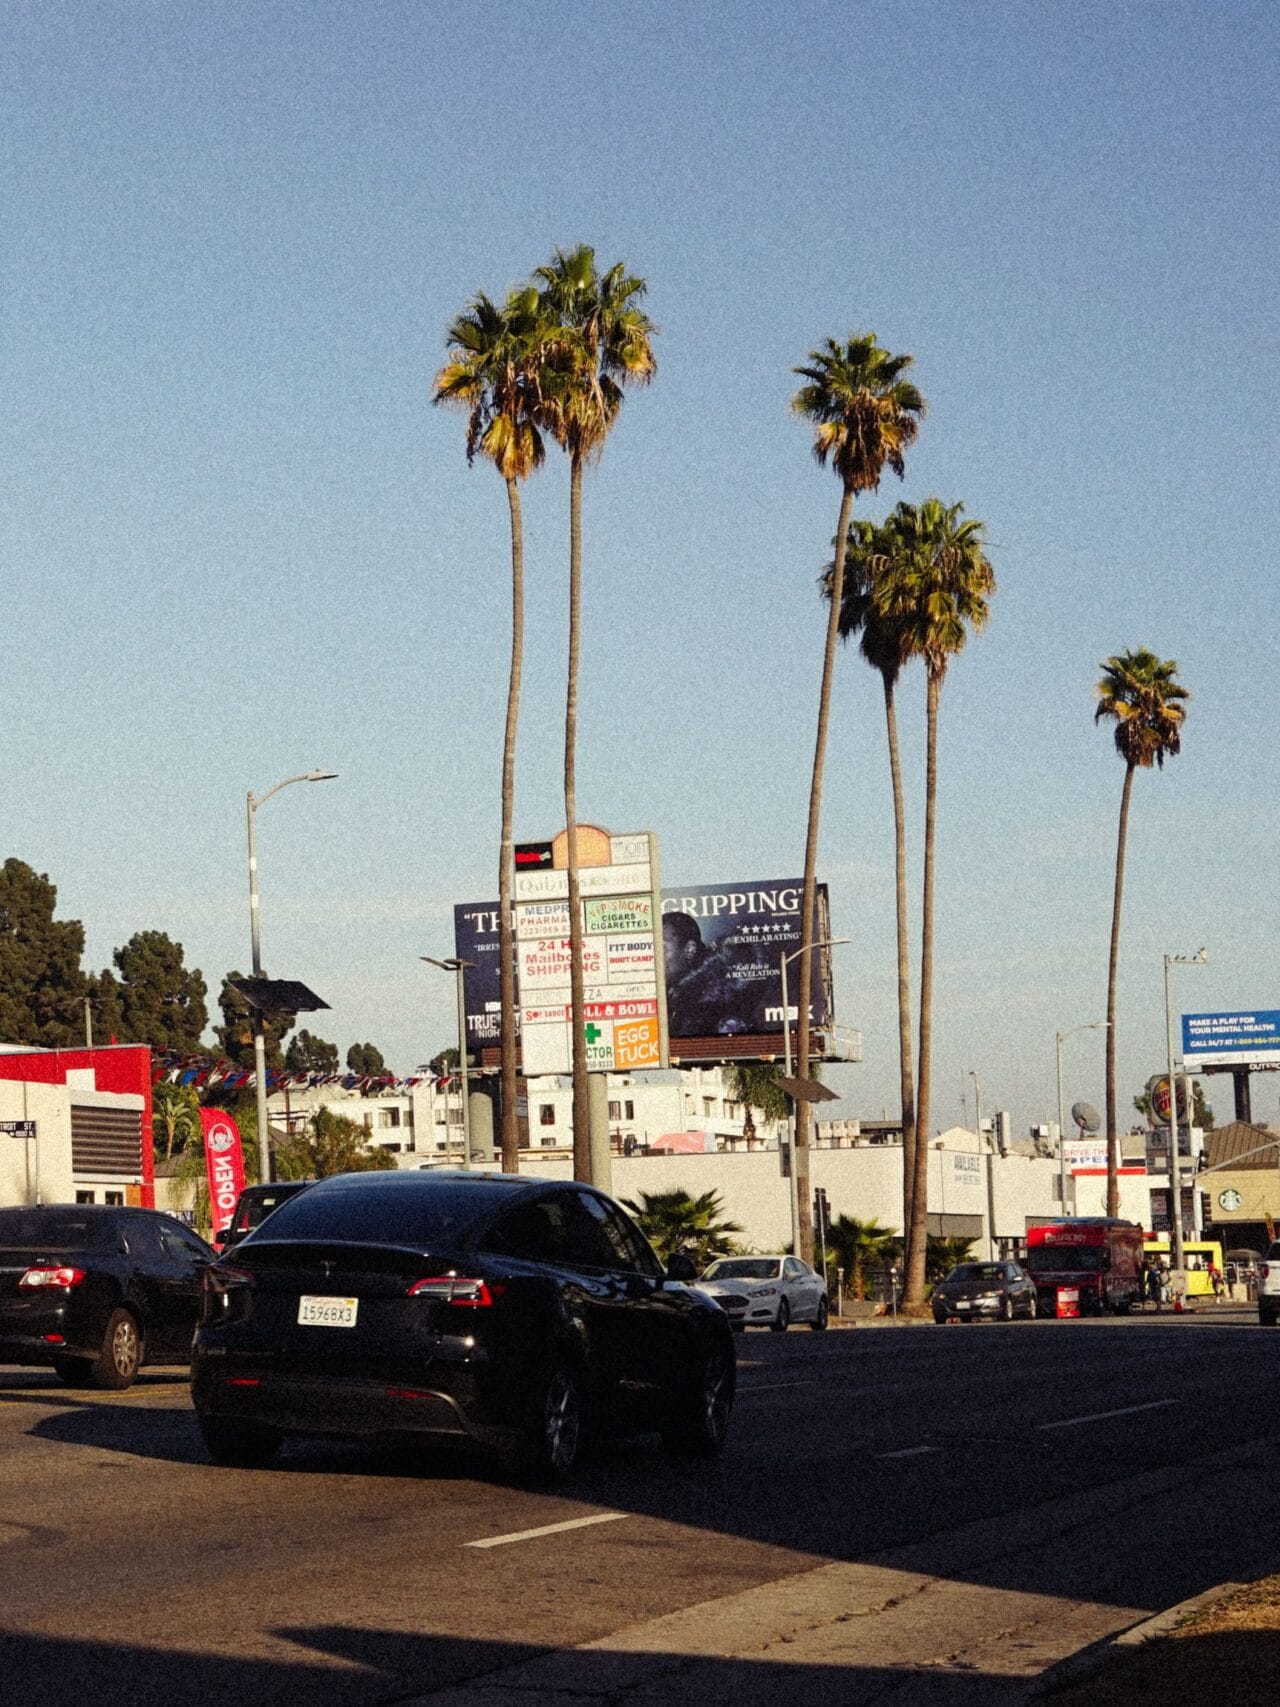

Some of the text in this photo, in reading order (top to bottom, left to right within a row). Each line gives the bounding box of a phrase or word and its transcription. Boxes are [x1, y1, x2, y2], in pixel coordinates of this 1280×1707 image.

[525, 904, 570, 916] MEDPR
[612, 901, 650, 915] SMOKE
[520, 915, 569, 926] PHARMA
[601, 913, 636, 922] CIGARS
[591, 920, 649, 931] CIGARETTES
[538, 940, 556, 952] 24
[609, 942, 653, 952] FIT BODY
[526, 951, 601, 964] Mailboes
[609, 955, 655, 964] BOOT CAMP
[526, 961, 601, 977] SHIPPNG
[732, 969, 780, 978] REVELATION
[605, 1005, 615, 1016] &
[619, 1003, 657, 1015] BOWL
[467, 1014, 497, 1031] TRUE
[1189, 1016, 1256, 1027] MAKE A PLAY FOR
[477, 1028, 501, 1039] NIGH
[618, 1025, 650, 1046] EGG
[1189, 1027, 1211, 1035] YOUR
[1212, 1026, 1243, 1034] MENTAL
[1190, 1040, 1207, 1048] CALL
[586, 1046, 613, 1059] CTOR
[617, 1041, 660, 1064] TUCK
